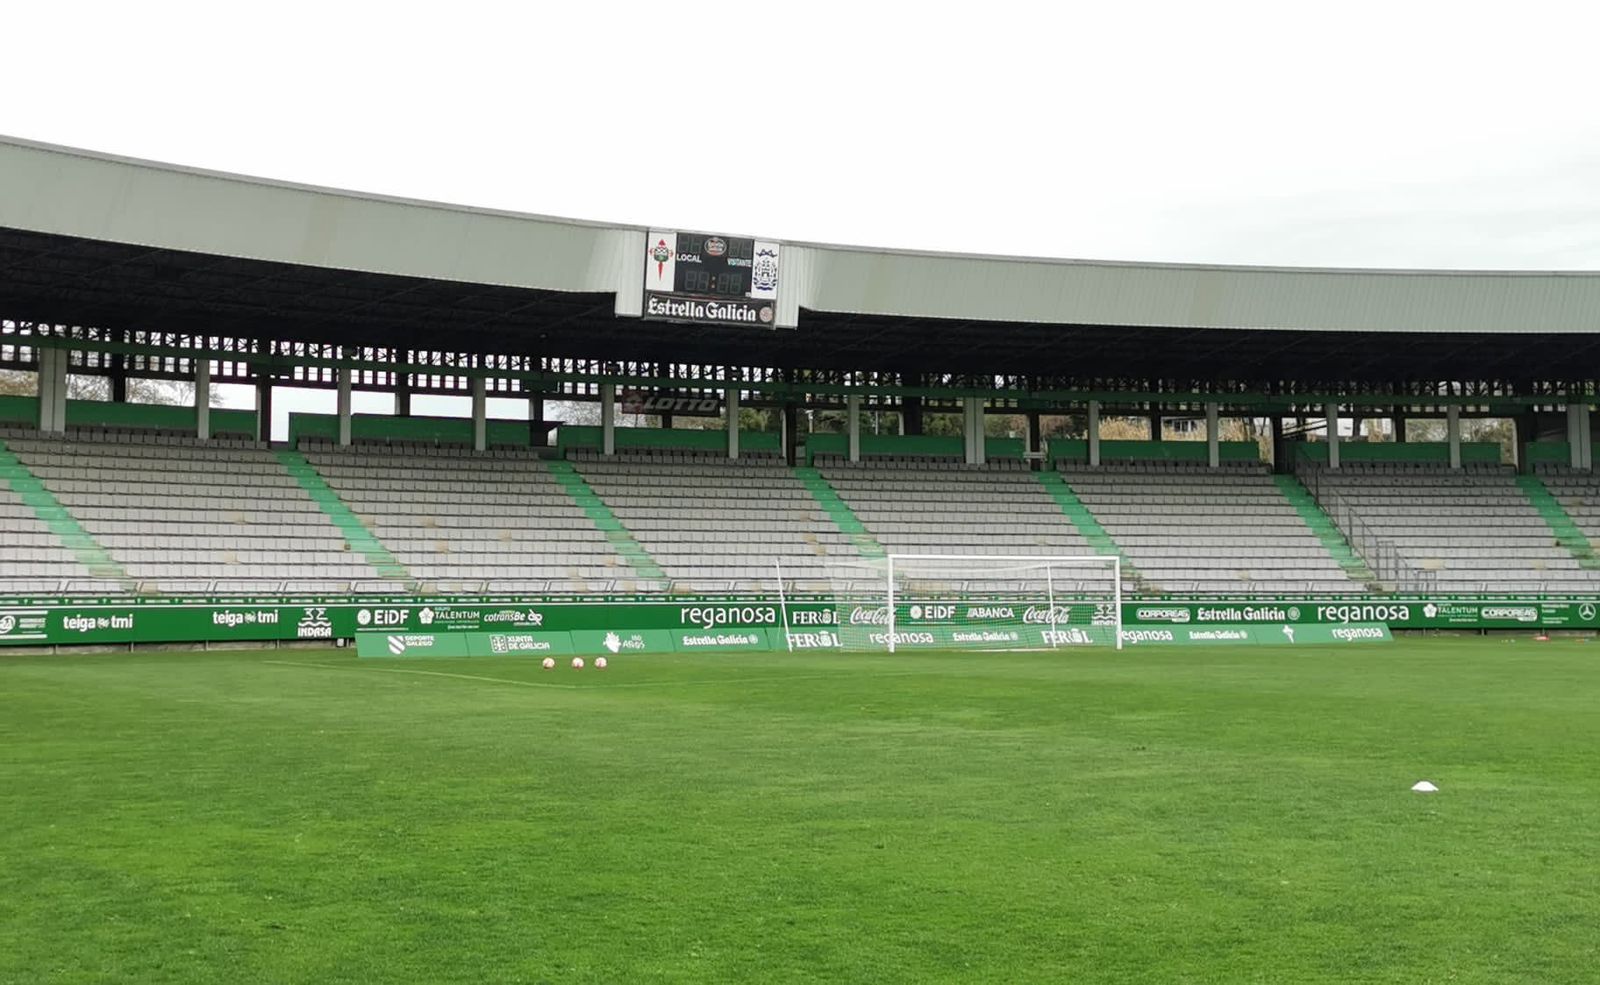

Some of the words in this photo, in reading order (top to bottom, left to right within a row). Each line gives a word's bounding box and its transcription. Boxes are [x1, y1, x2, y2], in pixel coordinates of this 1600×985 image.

[677, 254, 702, 263] LOCAL
[647, 298, 704, 318] Estrella
[705, 302, 757, 321] Galicia
[644, 397, 719, 411] LOTTO
[213, 609, 243, 627] teiga
[258, 609, 278, 623] tmi
[435, 611, 480, 619] TALENTUM
[681, 606, 776, 629] reganosa
[972, 608, 1014, 618] ABANCA
[1197, 607, 1242, 621] Estrella
[1243, 607, 1285, 620] Galicia
[1317, 605, 1409, 624] reganosa
[63, 614, 96, 631] teiga
[111, 614, 133, 629] tmi
[298, 627, 331, 637] INDASA
[953, 632, 982, 641] Estrella
[983, 632, 1010, 641] Galicia
[1121, 630, 1173, 644] eganosa
[1332, 628, 1384, 641] reganosa
[682, 635, 717, 646] Estrella
[718, 635, 748, 645] Galicia
